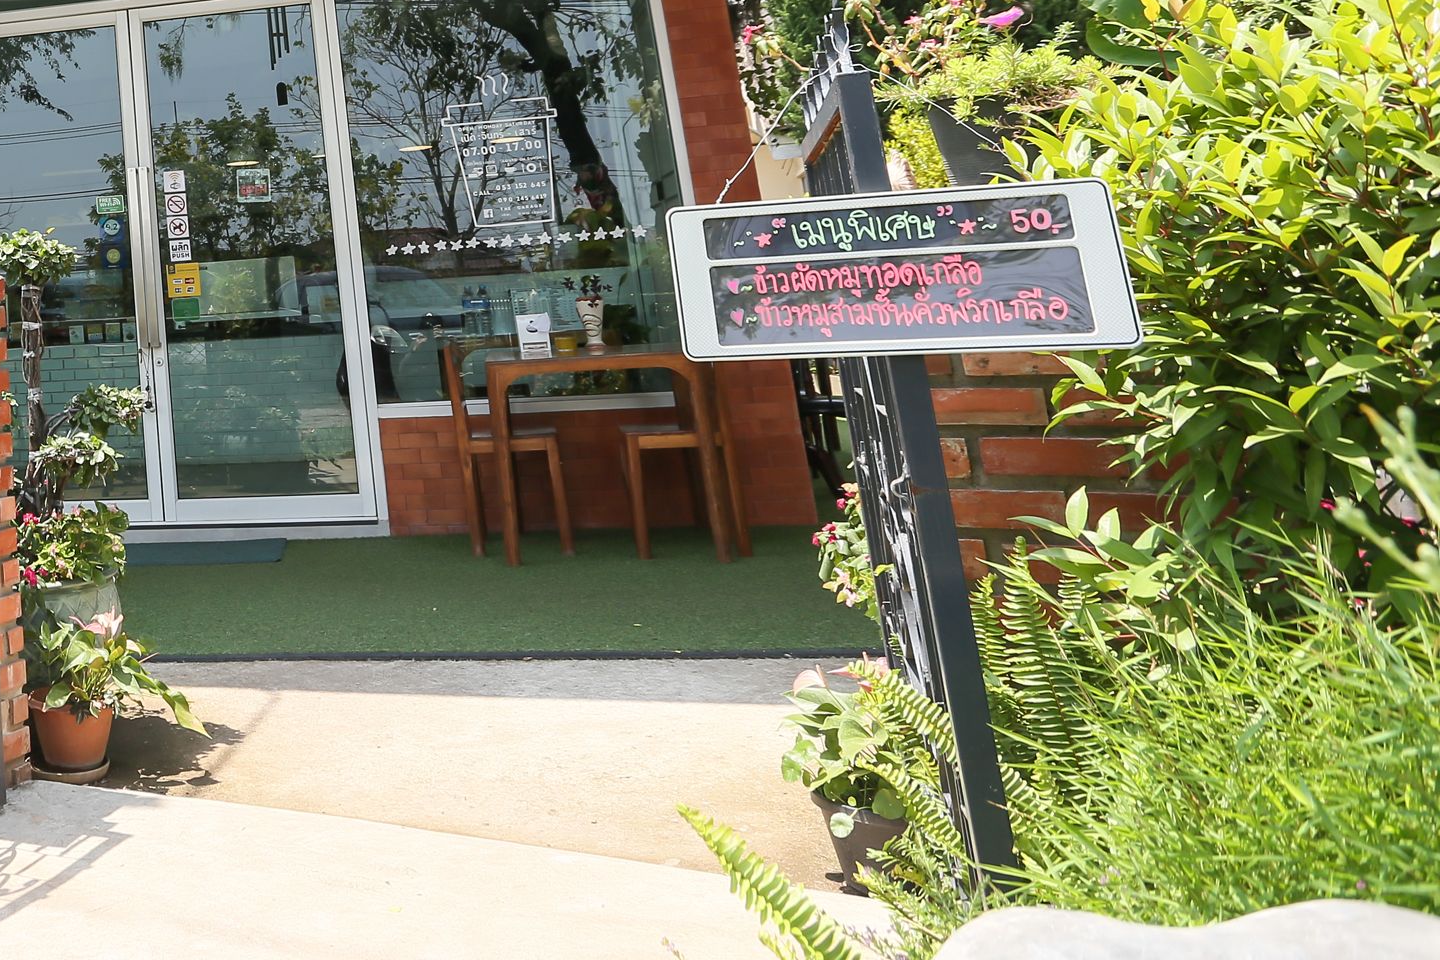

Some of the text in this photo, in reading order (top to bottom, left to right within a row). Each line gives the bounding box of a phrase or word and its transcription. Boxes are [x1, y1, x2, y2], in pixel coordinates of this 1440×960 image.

[462, 145, 496, 157] 07.00
[505, 140, 542, 152] 17.00
[105, 223, 118, 231] 9.2
